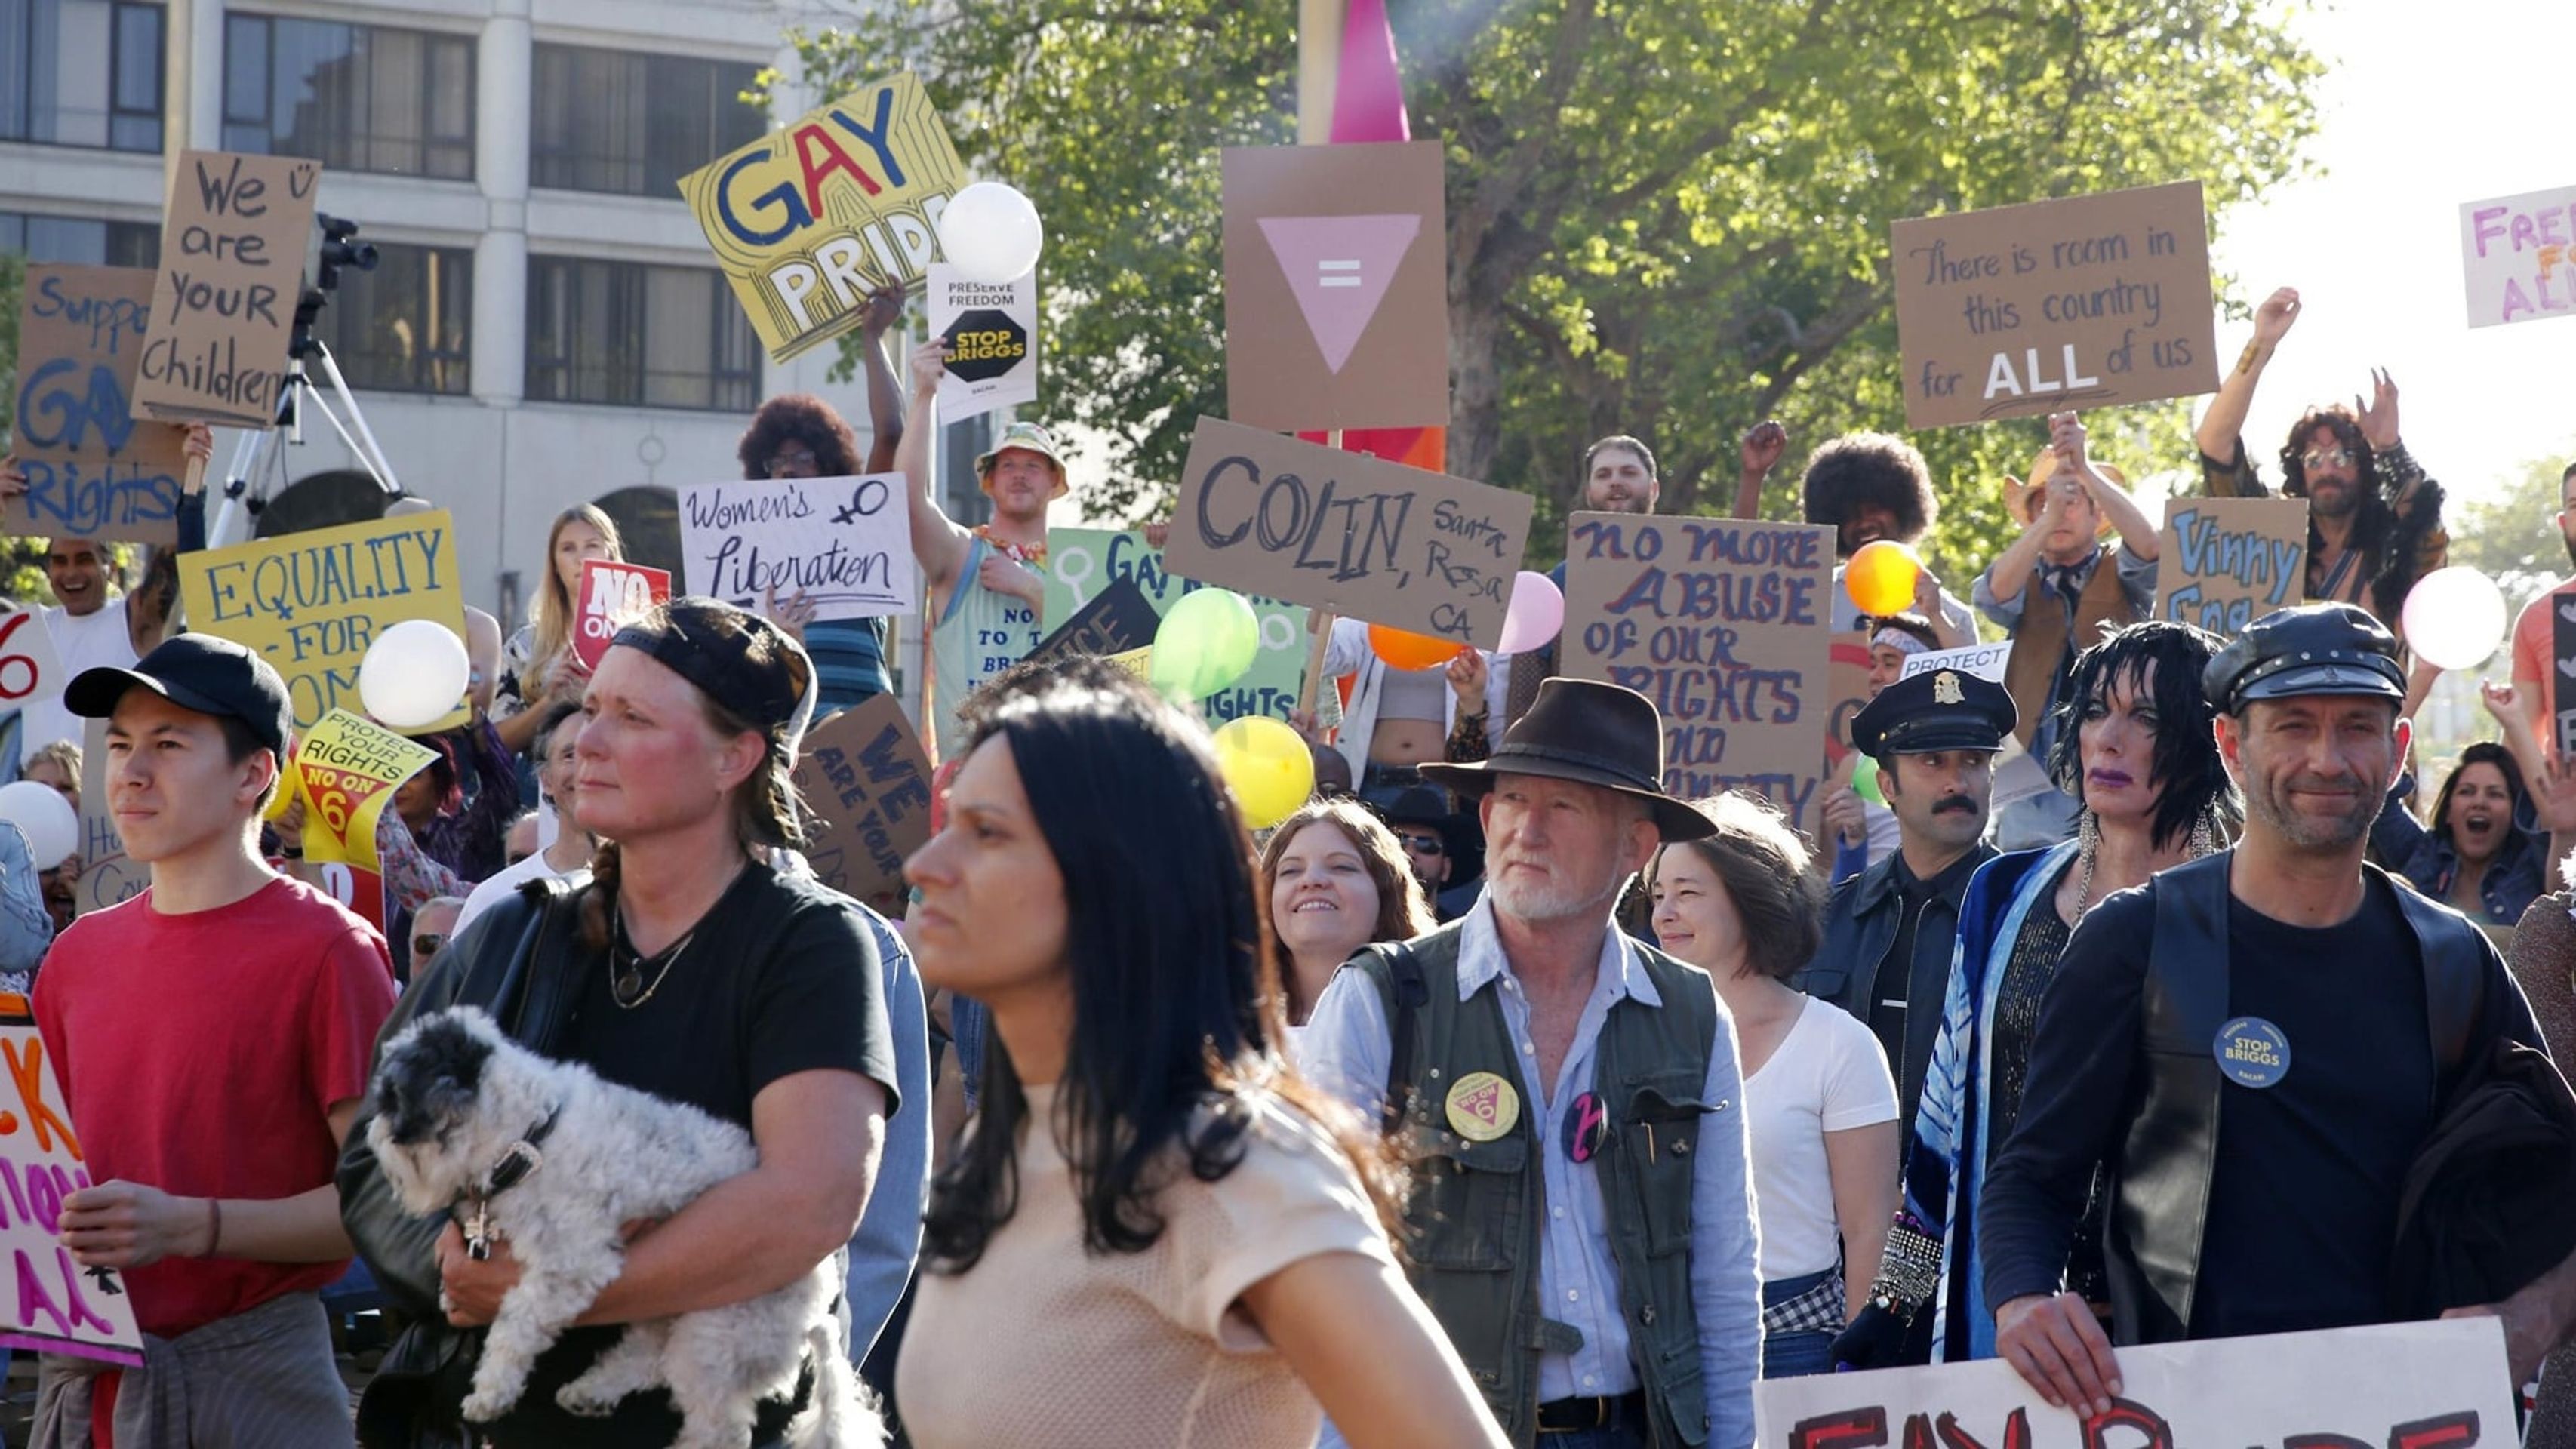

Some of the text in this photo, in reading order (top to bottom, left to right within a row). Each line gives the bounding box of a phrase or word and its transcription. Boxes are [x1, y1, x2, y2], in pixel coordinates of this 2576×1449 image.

[197, 158, 266, 217] We
[718, 88, 906, 246] GAY
[180, 226, 270, 266] are
[2473, 202, 2576, 258] FRE
[1909, 226, 2175, 285] There is room in
[33, 276, 149, 355] Suppo
[949, 295, 1014, 306] FREEDOM
[1964, 278, 2160, 334] this country
[956, 330, 1011, 348] STOP
[141, 336, 280, 412] Children
[1920, 328, 2193, 399] for ALL of us
[18, 458, 180, 534] Rights
[686, 484, 815, 529] Women's
[1433, 499, 1507, 559] Santa
[205, 528, 442, 622] EQUALITY
[705, 536, 891, 601] Liberation
[1426, 540, 1502, 601] Rosa
[2171, 508, 2302, 605] Vinny
[586, 567, 652, 615] NO
[1605, 566, 1817, 626] ABUSE
[288, 614, 373, 663] FOR
[584, 617, 620, 639] ON
[979, 630, 1008, 645] TO
[1005, 608, 1033, 623] NO
[1430, 603, 1473, 640] CA
[0, 613, 38, 699] 6
[1650, 626, 1753, 669] OUR
[1906, 648, 2007, 675] PROTECT
[1205, 688, 1295, 717] IGHTS
[1606, 666, 1802, 724] RIGHTS
[303, 739, 404, 780] RIGHTS
[327, 713, 433, 759] PROTECT
[340, 731, 399, 761] YOUR
[1665, 724, 1726, 766] ND
[307, 768, 378, 794] NO ON
[814, 747, 866, 810] ARE
[321, 791, 346, 831] 6
[2225, 1047, 2279, 1066] BRIGGS
[2235, 1037, 2272, 1052] STOP
[1476, 1100, 1494, 1119] 6
